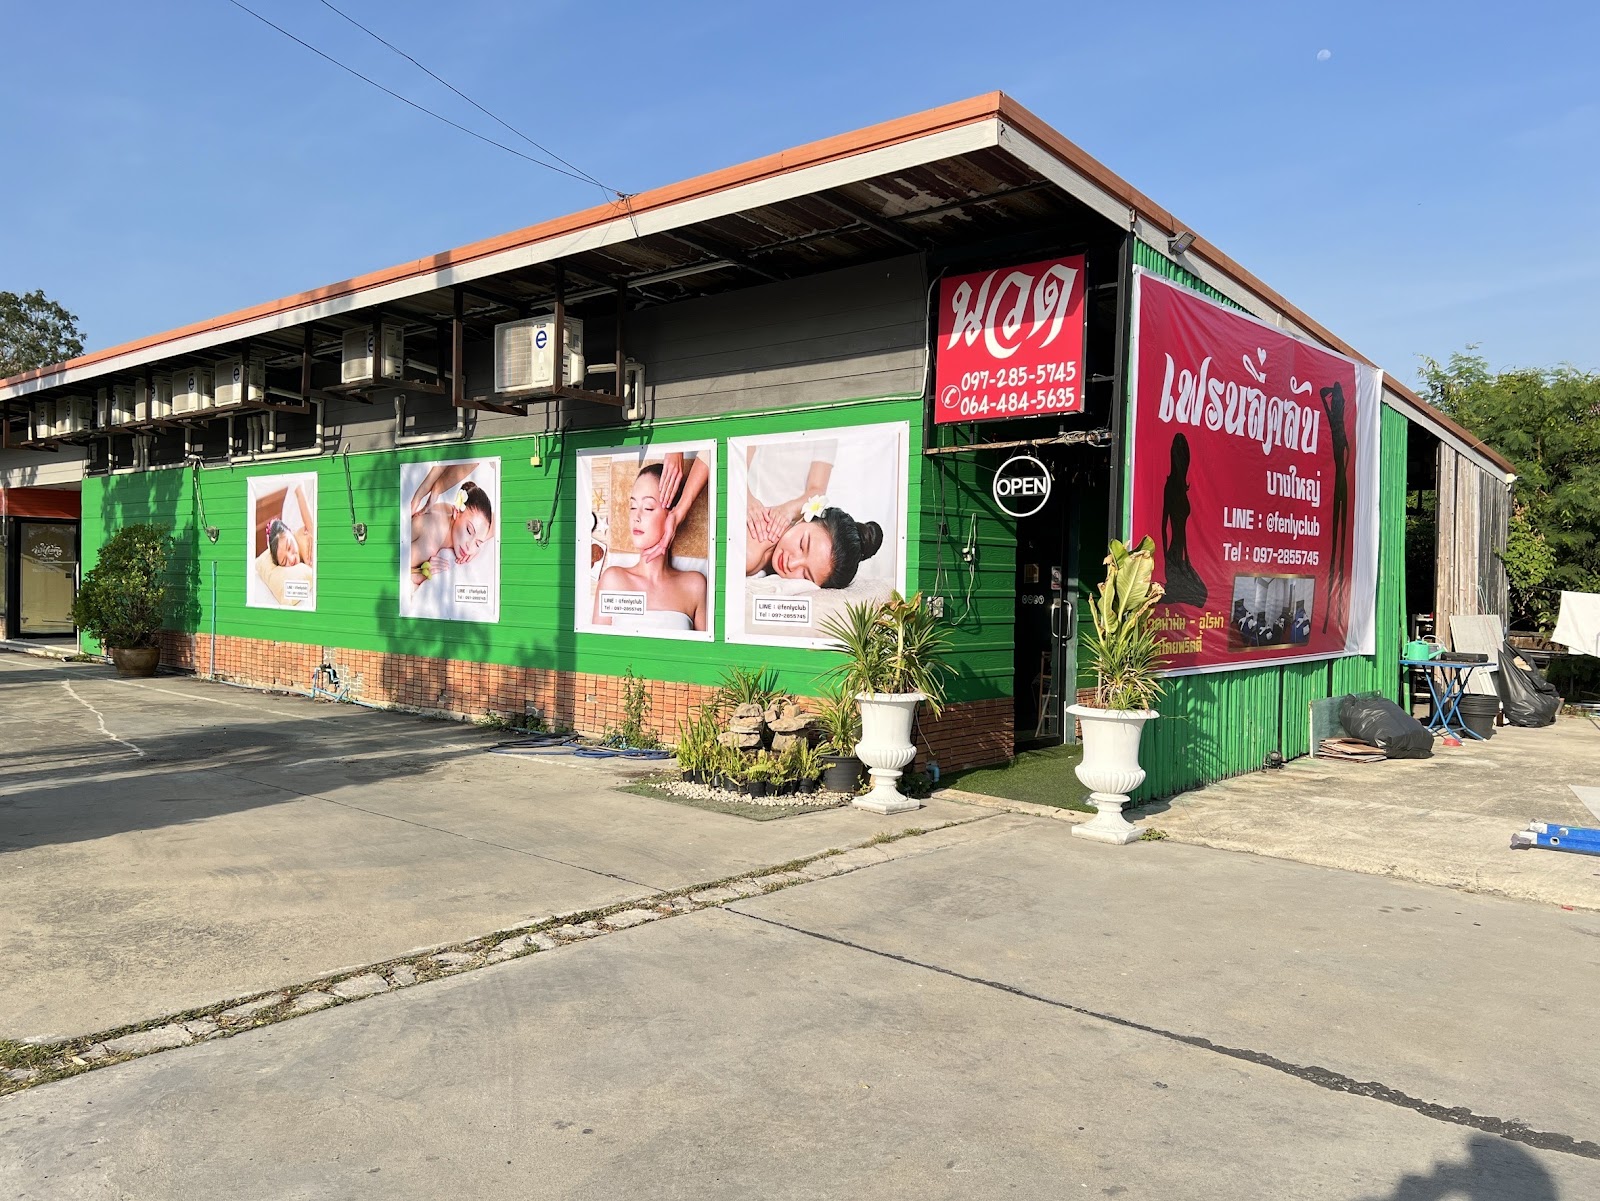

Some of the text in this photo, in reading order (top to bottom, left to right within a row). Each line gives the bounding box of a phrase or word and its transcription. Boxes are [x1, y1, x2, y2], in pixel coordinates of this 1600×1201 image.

[946, 263, 1079, 359] นวด
[961, 361, 1077, 391] 097-285-5745
[960, 387, 1076, 416] 064-484-5635
[996, 477, 1047, 496] OPEN
[1266, 465, 1321, 508] บางใหญ่
[1223, 506, 1254, 530] LINE
[1266, 511, 1320, 540] @fenlyclub
[1222, 542, 1242, 562] Tel
[1252, 546, 1319, 566] 097-2855745
[1199, 611, 1224, 630] อโรม่า
